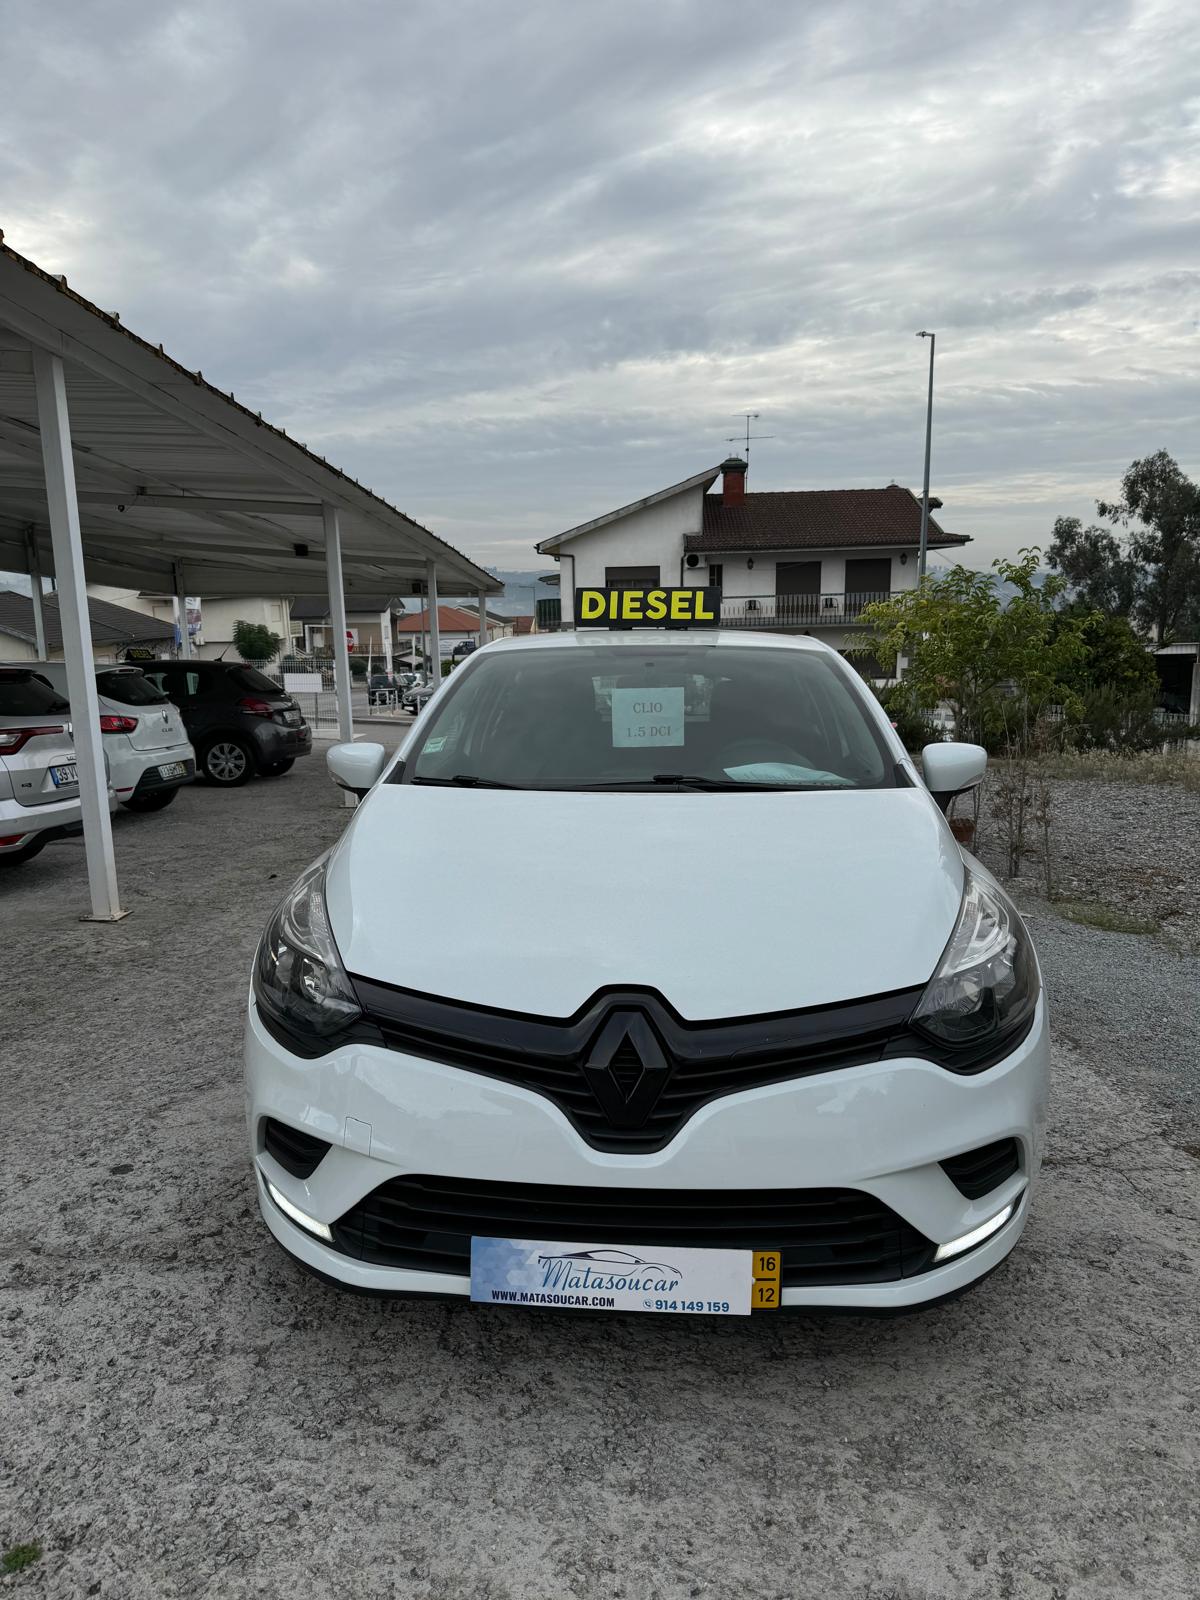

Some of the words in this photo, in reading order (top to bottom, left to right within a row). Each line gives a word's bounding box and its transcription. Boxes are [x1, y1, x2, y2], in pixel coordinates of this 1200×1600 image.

[581, 590, 714, 620] DIESEL
[633, 702, 663, 713] CLIO
[627, 727, 646, 737] 1.5
[650, 726, 671, 737] DCI
[759, 1257, 776, 1272] 16
[543, 1258, 679, 1292] Matasoucar
[491, 1290, 615, 1307] WWW.MATASOUCAR.COM
[758, 1287, 775, 1303] 12
[655, 1299, 678, 1311] 914
[681, 1300, 704, 1312] 149
[707, 1301, 730, 1313] 159
